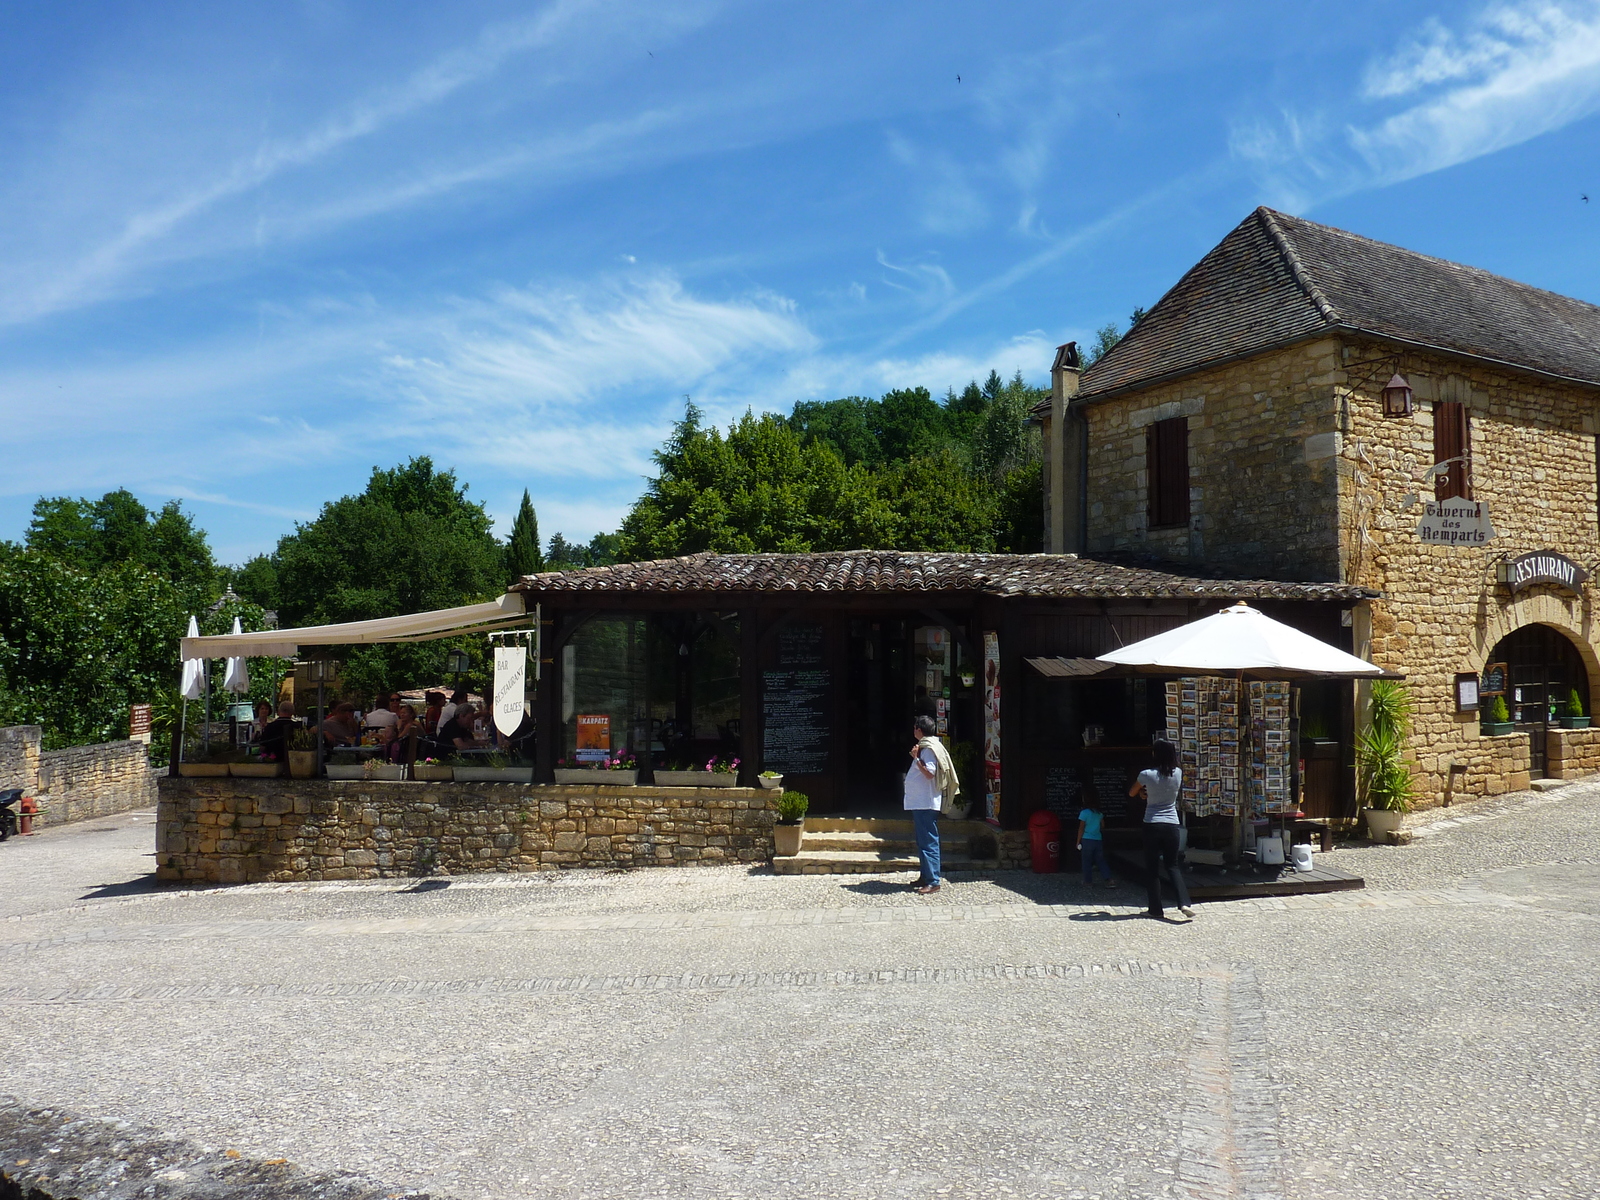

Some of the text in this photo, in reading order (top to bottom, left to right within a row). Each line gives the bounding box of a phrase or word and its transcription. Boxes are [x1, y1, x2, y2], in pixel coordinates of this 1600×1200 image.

[1426, 504, 1481, 518] Taverne
[1442, 519, 1461, 529] des
[1421, 526, 1486, 544] Remparts
[497, 660, 509, 671] BAR
[494, 665, 524, 706] RESTAURANT
[503, 701, 522, 714] GLACES
